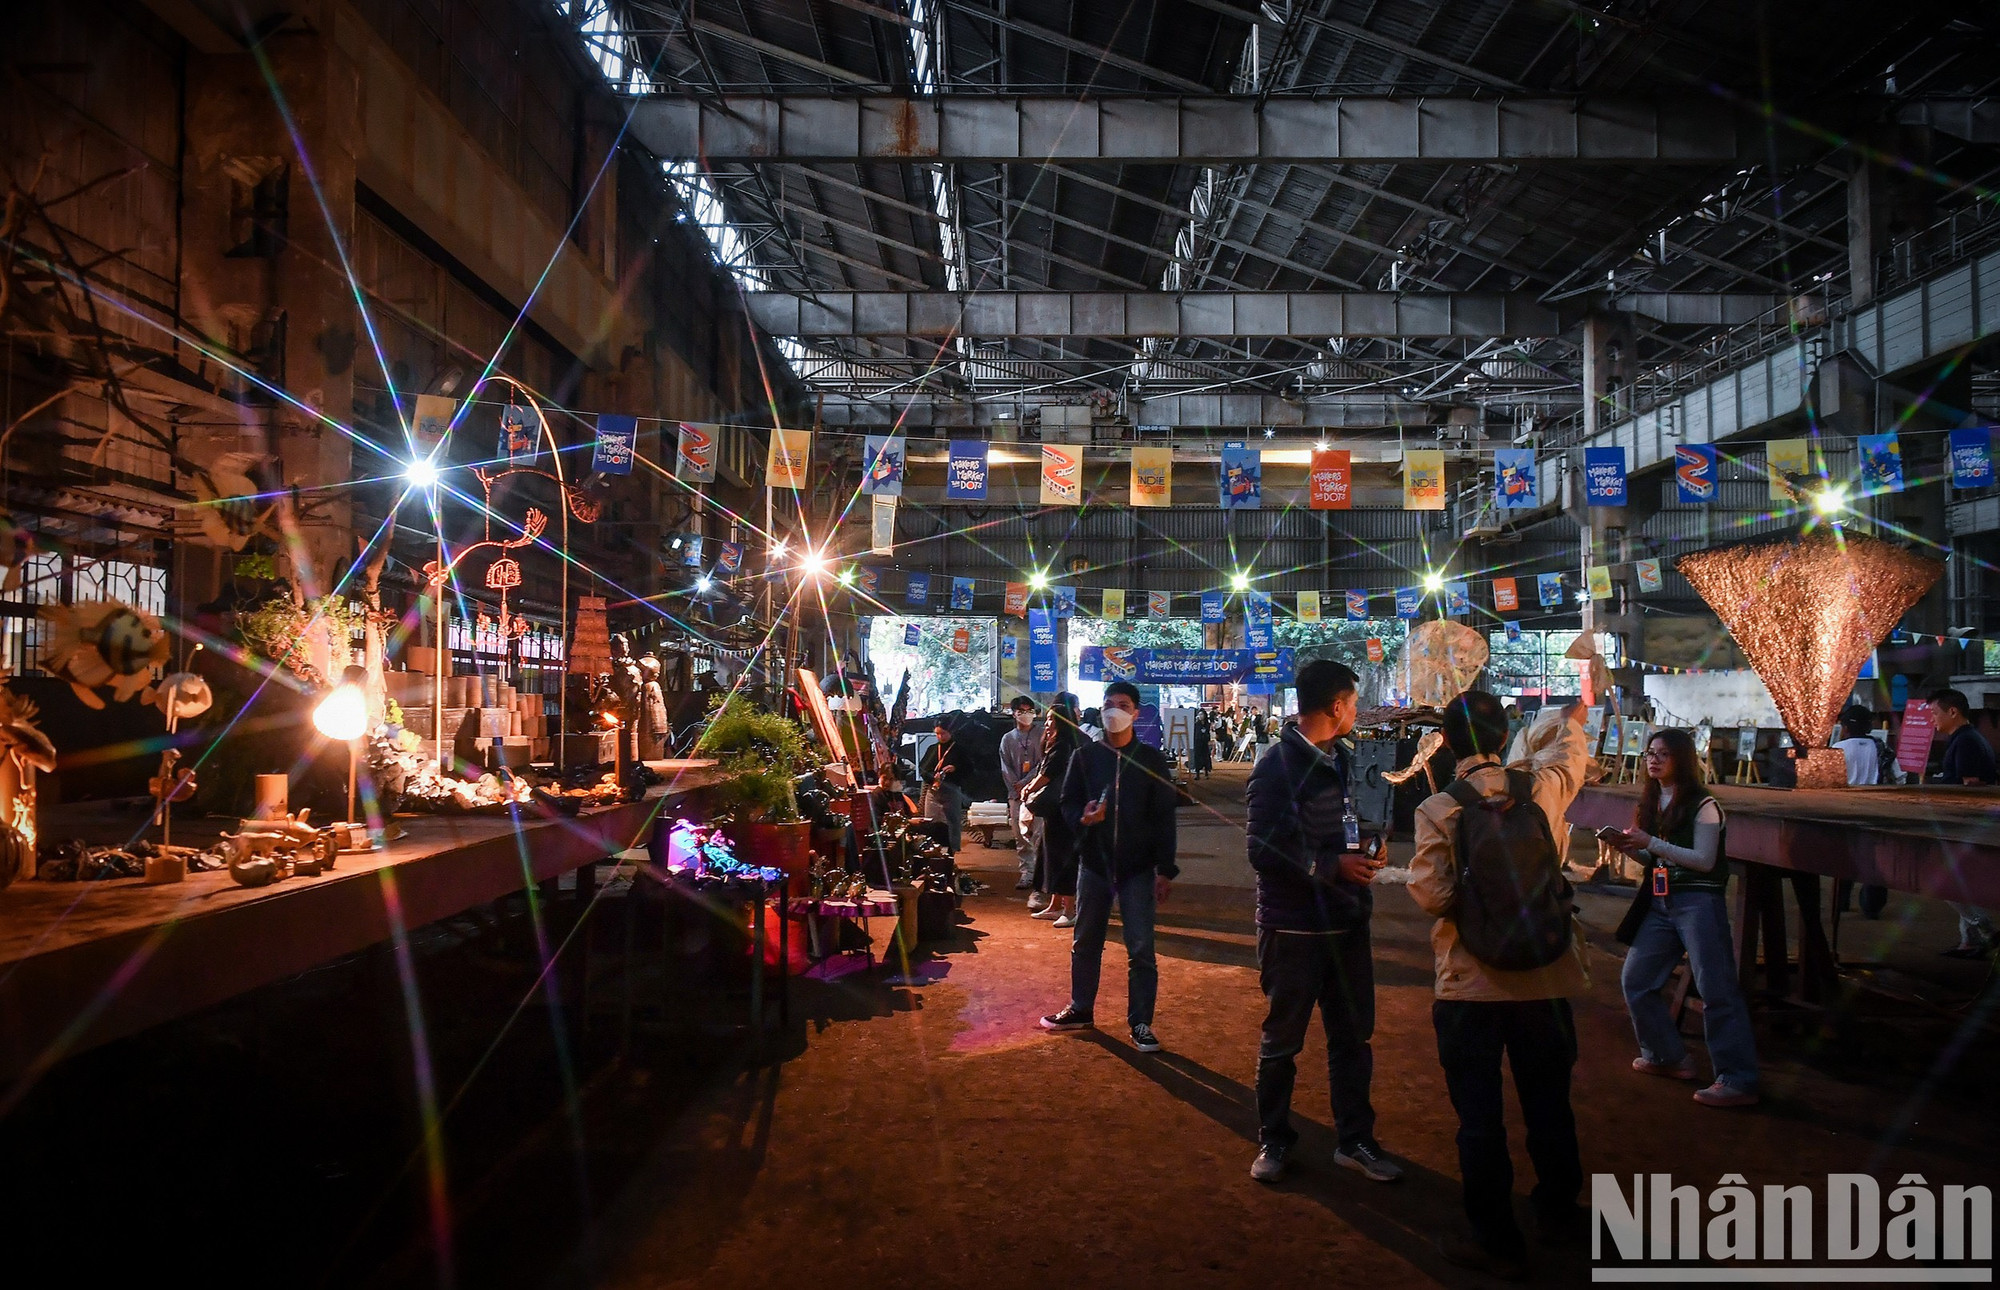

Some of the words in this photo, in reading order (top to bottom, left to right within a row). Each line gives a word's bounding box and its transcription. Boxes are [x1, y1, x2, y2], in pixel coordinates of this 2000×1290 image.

[960, 480, 983, 490] DOTS
[1137, 475, 1166, 485] INDIE
[1410, 478, 1439, 488] INDIE
[1323, 492, 1346, 501] DOTS
[1599, 487, 1622, 497] DOTS
[1213, 660, 1238, 671] DOTS
